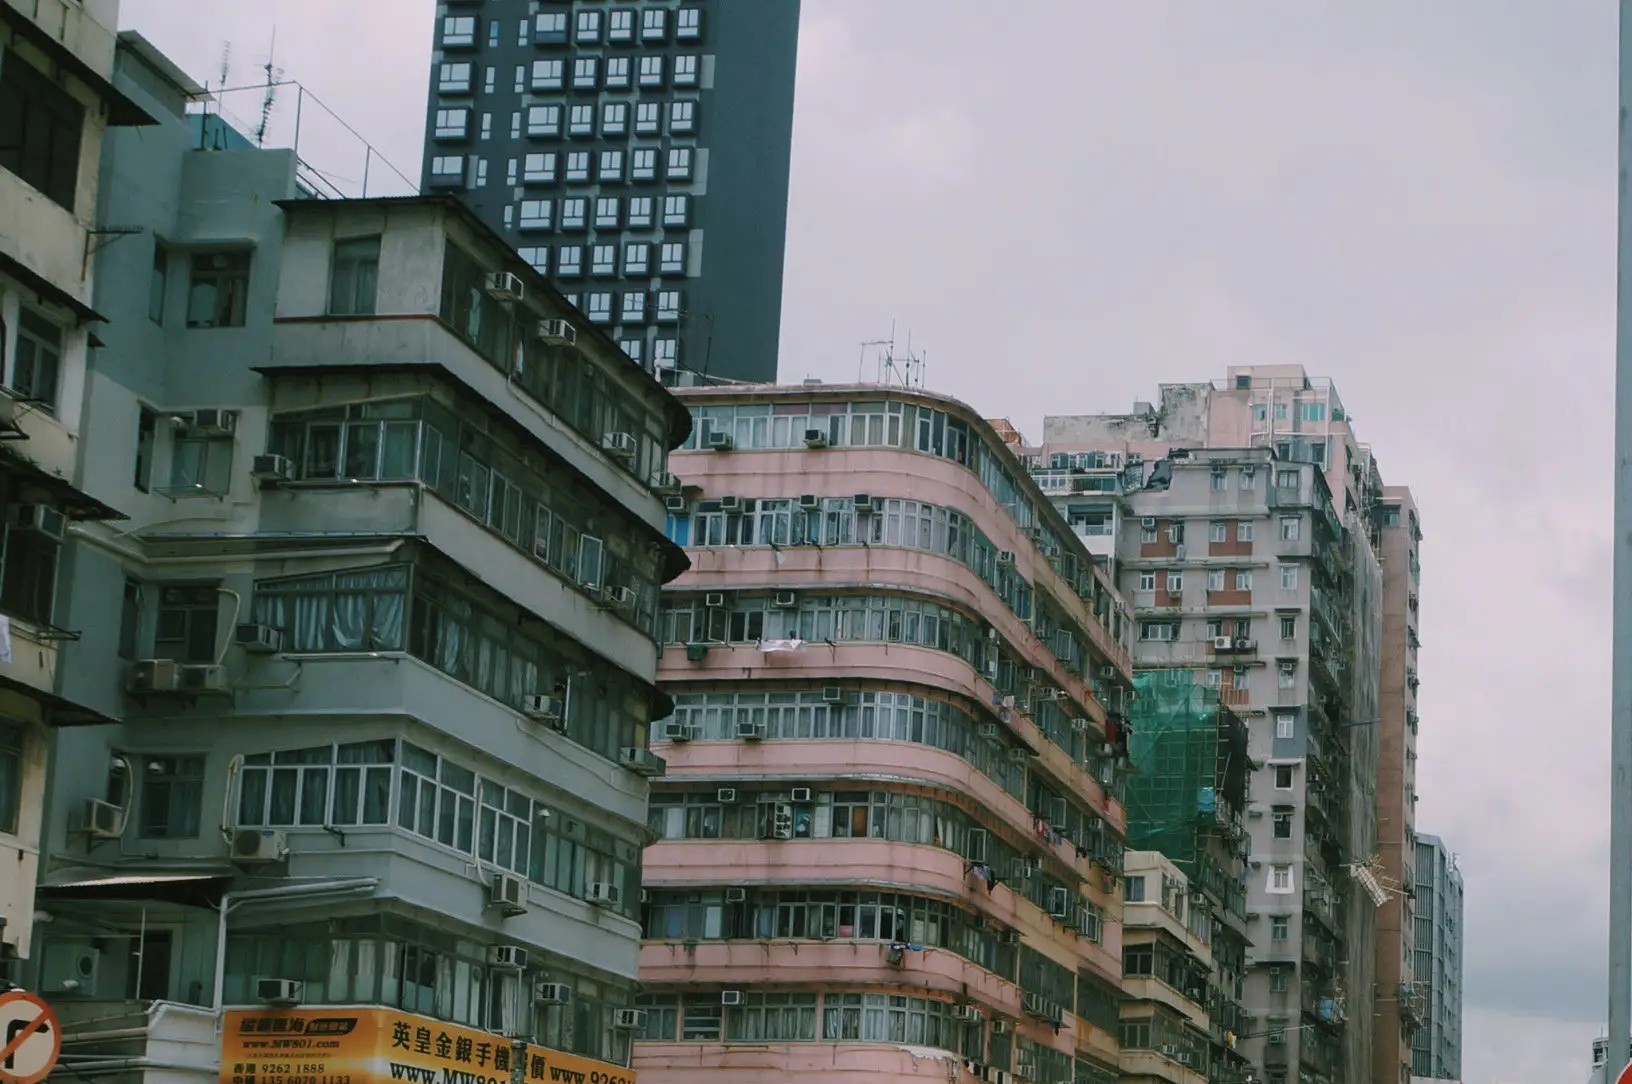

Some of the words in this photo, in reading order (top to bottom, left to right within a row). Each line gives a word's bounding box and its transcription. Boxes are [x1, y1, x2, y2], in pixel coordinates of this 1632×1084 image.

[243, 1039, 340, 1049] www.MW801.com
[391, 1021, 546, 1081] 英皇金銀手機價
[262, 1063, 291, 1074] 9262
[297, 1063, 325, 1074] 1888
